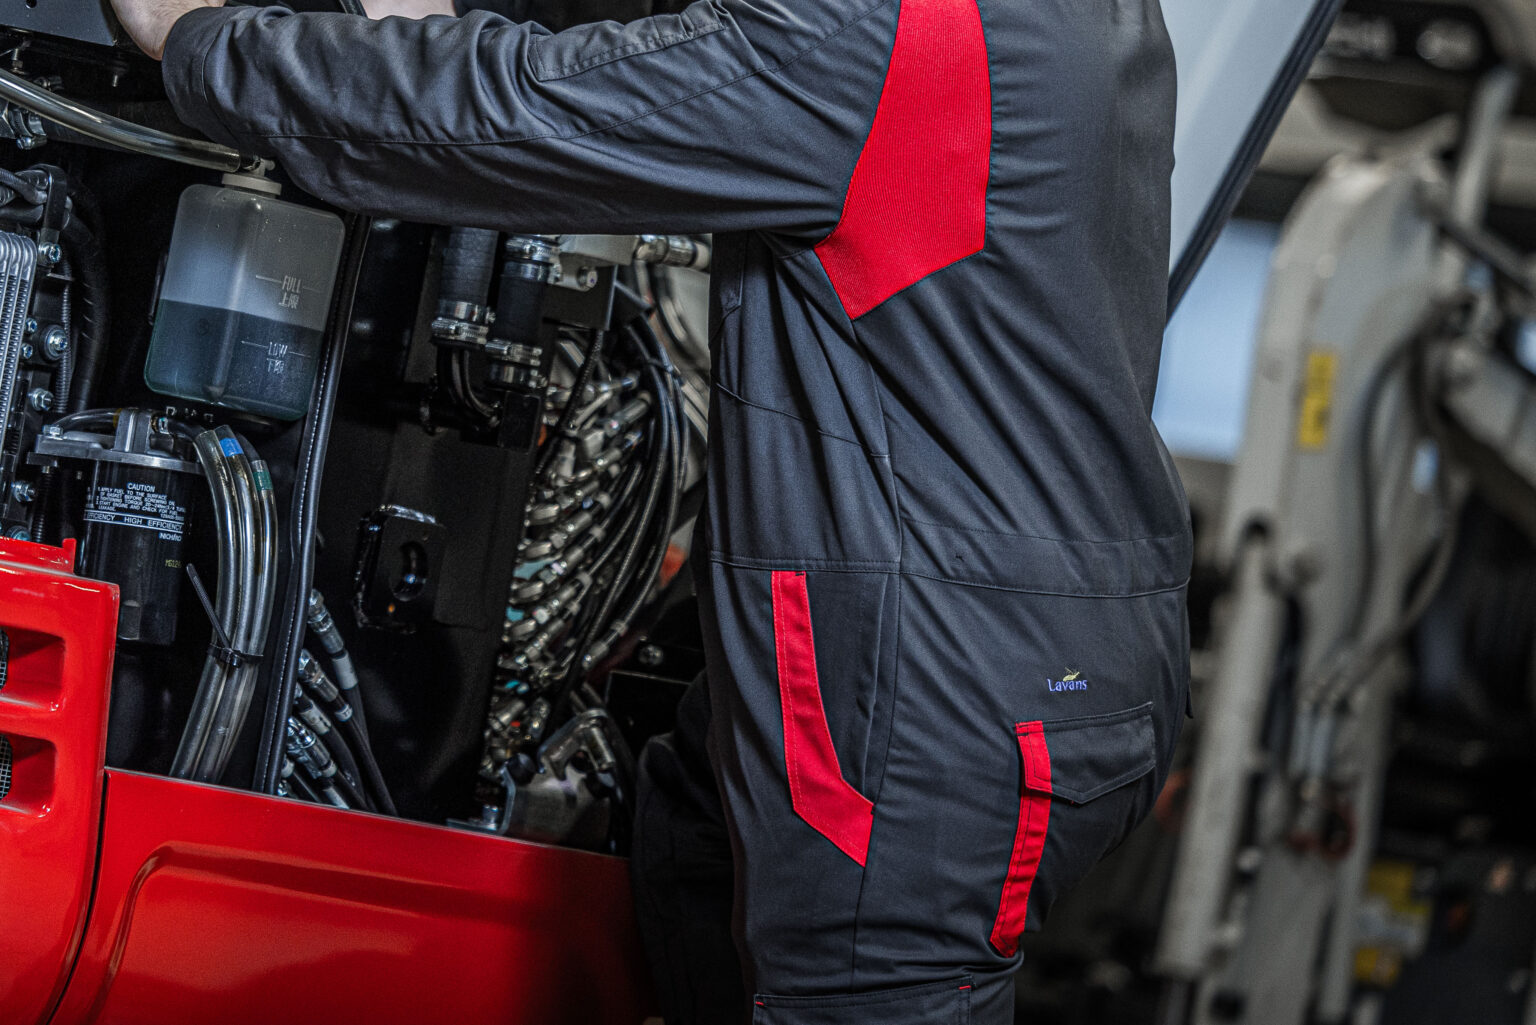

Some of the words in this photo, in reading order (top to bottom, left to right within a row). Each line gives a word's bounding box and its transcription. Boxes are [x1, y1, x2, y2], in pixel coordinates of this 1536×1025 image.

[282, 275, 301, 293] FULL
[268, 341, 288, 357] LOW
[127, 482, 156, 493] CAUTION
[124, 516, 143, 525] HIGH
[147, 520, 183, 532] EFFICIENCY
[1046, 678, 1088, 692] Lavans
